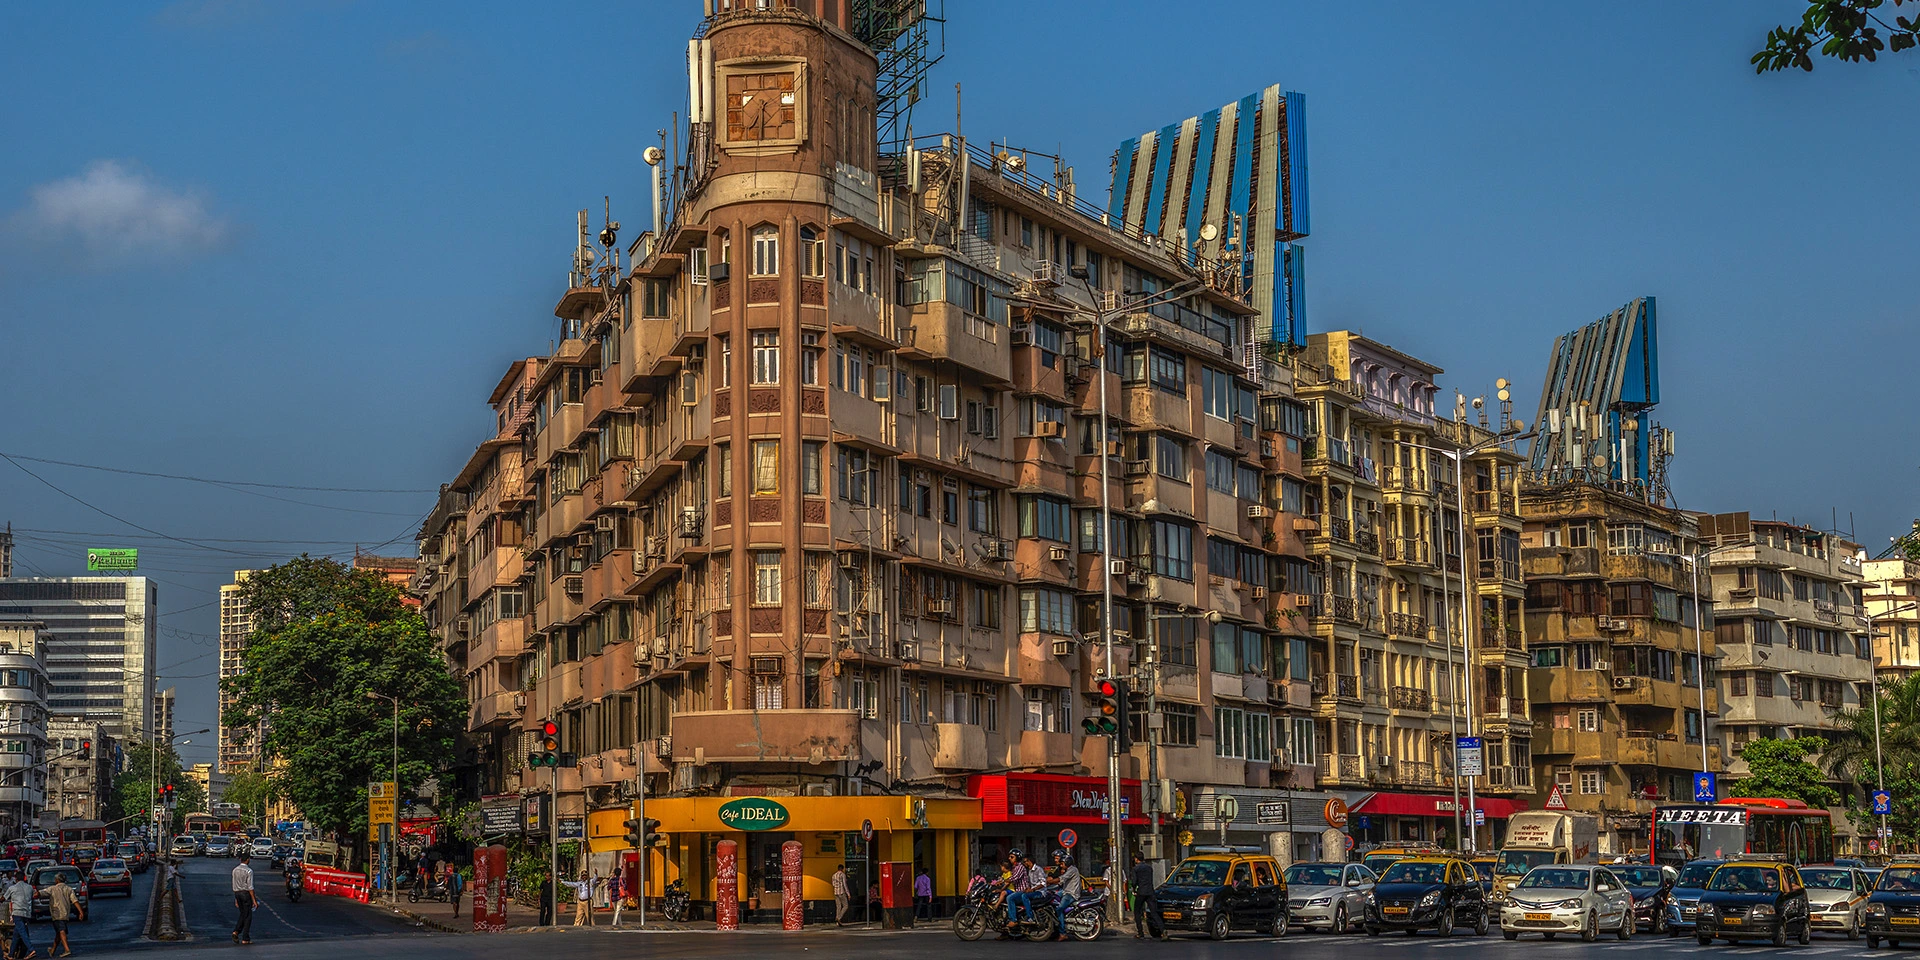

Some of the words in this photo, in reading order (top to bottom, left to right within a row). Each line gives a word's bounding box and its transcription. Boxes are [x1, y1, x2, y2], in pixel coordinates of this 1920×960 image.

[721, 809, 740, 822] Cafe
[741, 807, 785, 821] IDEAL
[1657, 809, 1741, 824] NEETA
